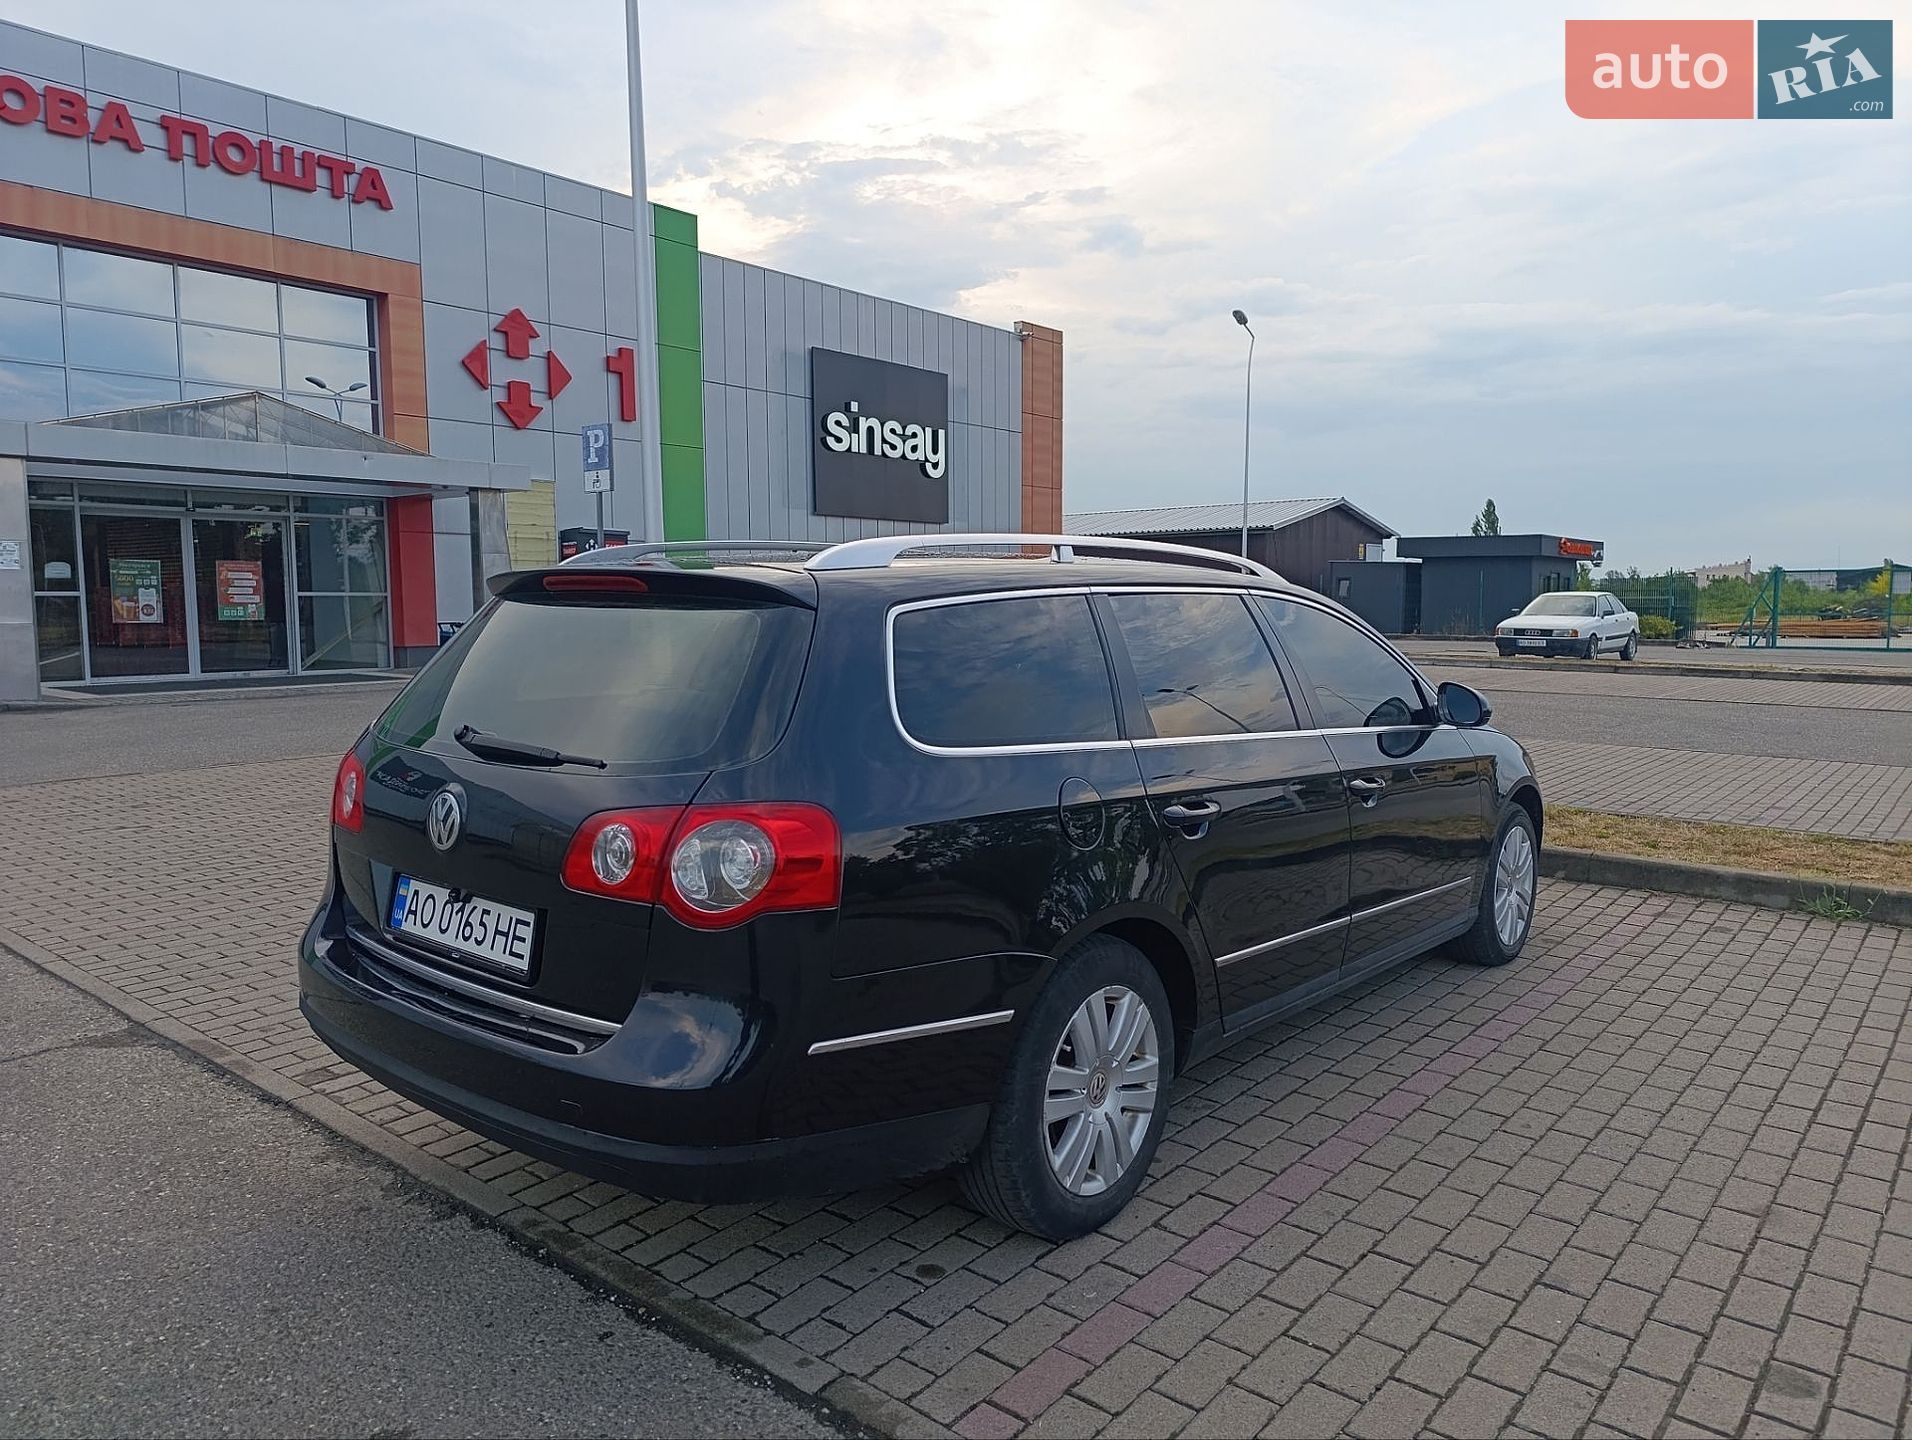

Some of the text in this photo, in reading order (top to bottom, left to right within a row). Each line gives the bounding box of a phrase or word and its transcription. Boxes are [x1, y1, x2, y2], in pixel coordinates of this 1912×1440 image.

[160, 114, 394, 211] ПОШТА
[586, 429, 604, 464] P
[825, 400, 946, 479] sinsay
[394, 910, 404, 921] UA
